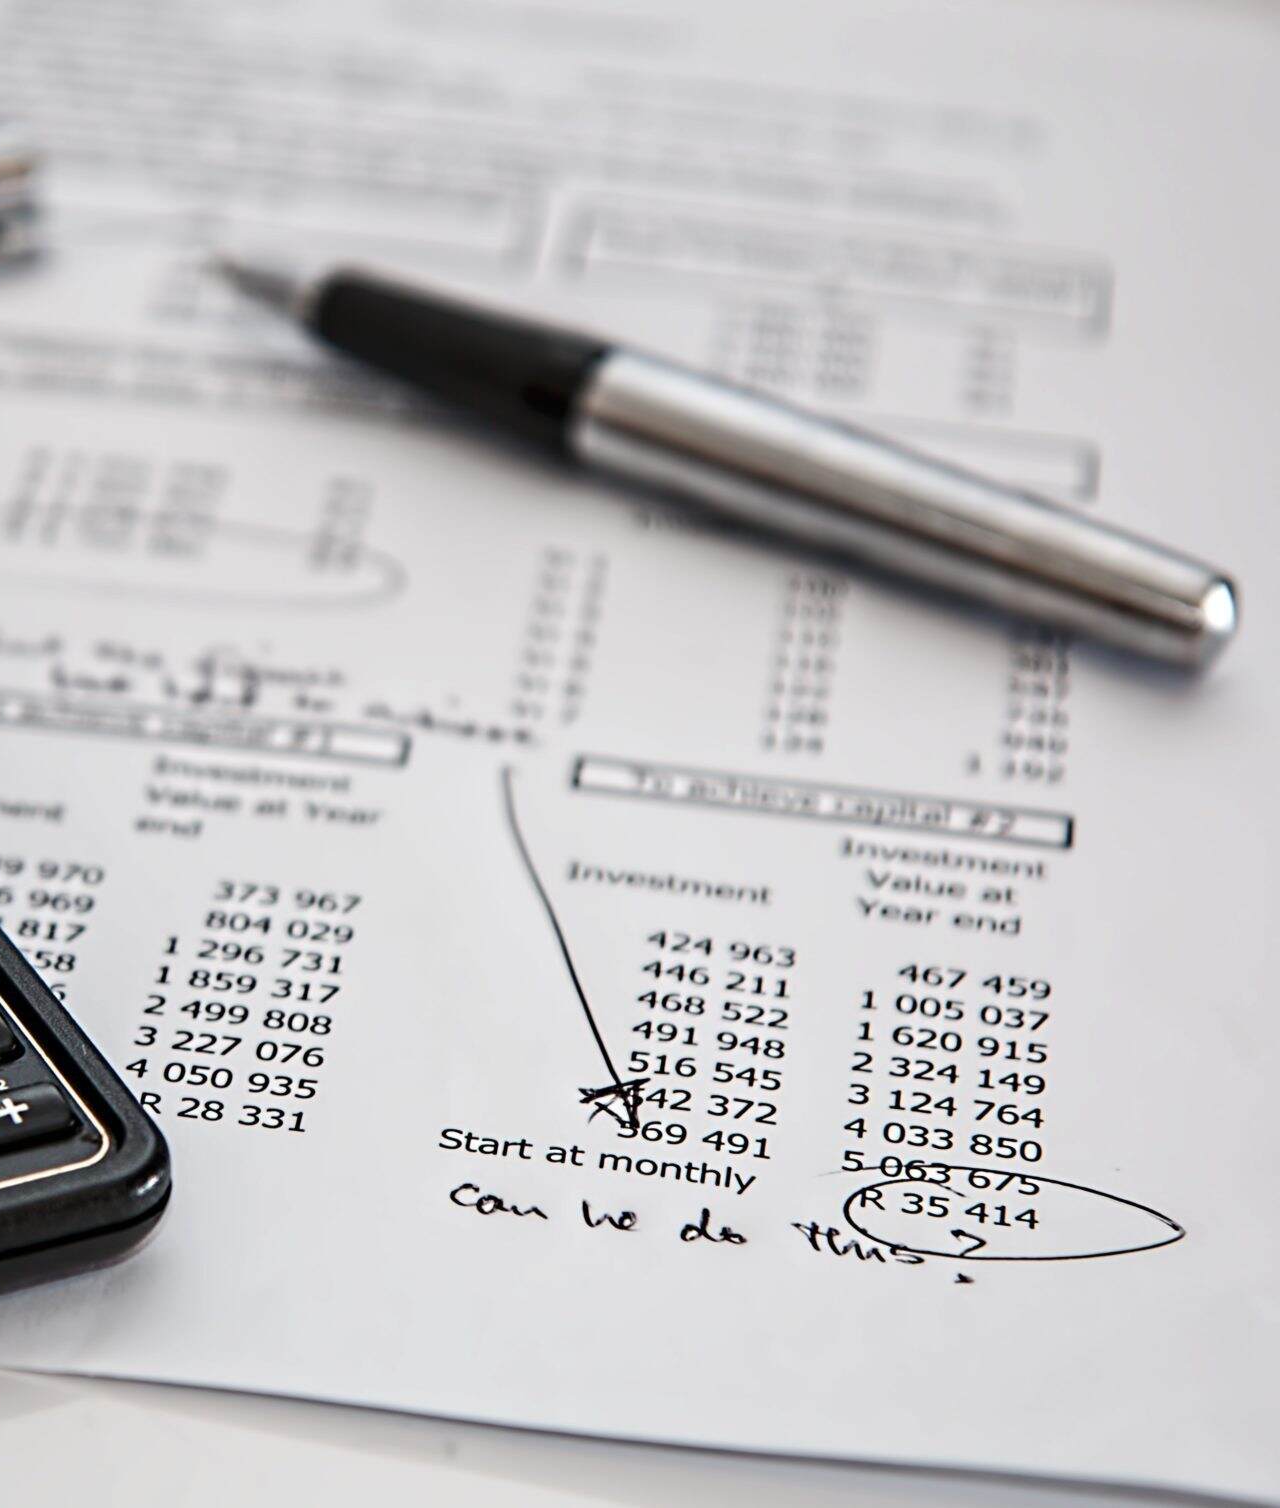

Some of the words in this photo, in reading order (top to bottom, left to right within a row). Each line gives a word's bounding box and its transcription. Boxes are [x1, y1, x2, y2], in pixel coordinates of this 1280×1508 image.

[153, 754, 350, 793] Investment
[146, 785, 240, 811] Value
[253, 799, 287, 816] at
[305, 801, 380, 826] Year
[135, 817, 203, 836] end
[38, 857, 105, 886] 970
[840, 837, 1047, 880] Investment
[29, 889, 94, 914] 969
[214, 880, 281, 906] 373
[294, 890, 362, 914] 967
[564, 860, 771, 906] Investment
[867, 868, 966, 900] Value
[980, 888, 1014, 906] at
[18, 918, 86, 942] 817
[205, 910, 272, 935] 804
[286, 920, 355, 944] 029
[859, 898, 936, 926] Year
[952, 912, 1021, 936] end
[165, 936, 178, 955] 1
[197, 939, 265, 965] 296
[281, 949, 342, 975] 731
[647, 931, 713, 957] 424
[729, 942, 796, 968] 963
[156, 965, 170, 985] 1
[188, 969, 258, 994] 859
[270, 978, 340, 1004] 317
[642, 960, 710, 986] 446
[725, 972, 787, 999] 211
[898, 964, 967, 989] 467
[982, 975, 1052, 1000] 459
[143, 994, 167, 1016] 2
[180, 1000, 250, 1025] 499
[262, 1009, 332, 1036] 808
[637, 990, 705, 1016] 468
[721, 1001, 789, 1030] 522
[861, 990, 874, 1010] 1
[895, 994, 964, 1021] 005
[979, 1005, 1050, 1031] 037
[133, 1025, 158, 1047] 3
[171, 1030, 243, 1056] 227
[255, 1040, 324, 1068] 076
[632, 1020, 698, 1046] 491
[716, 1031, 785, 1059] 948
[858, 1021, 873, 1041] 1
[891, 1025, 963, 1053] 620
[977, 1036, 1048, 1064] 915
[125, 1058, 149, 1079] 4
[163, 1062, 234, 1089] 050
[247, 1072, 319, 1100] 935
[627, 1050, 697, 1078] 516
[712, 1061, 782, 1091] 545
[851, 1051, 873, 1074] 2
[888, 1056, 960, 1085] 324
[978, 1068, 1046, 1096] 149
[140, 1092, 161, 1114] R
[176, 1096, 225, 1122] 28
[237, 1104, 306, 1133] 331
[706, 1094, 777, 1126] 372
[847, 1083, 870, 1105] 3
[888, 1089, 958, 1117] 124
[973, 1099, 1045, 1129] 764
[701, 1130, 771, 1160] 491
[843, 1117, 868, 1139] 4
[882, 1122, 954, 1151] 033
[969, 1133, 1043, 1163] 850
[438, 1128, 534, 1160] Start
[545, 1145, 586, 1167] at
[598, 1152, 757, 1196] monthly
[842, 1151, 864, 1171] 5
[880, 1156, 951, 1184] 063
[968, 1168, 1040, 1195] 675
[860, 1188, 885, 1210] R
[902, 1193, 949, 1217] 35
[965, 1203, 1039, 1229] 414
